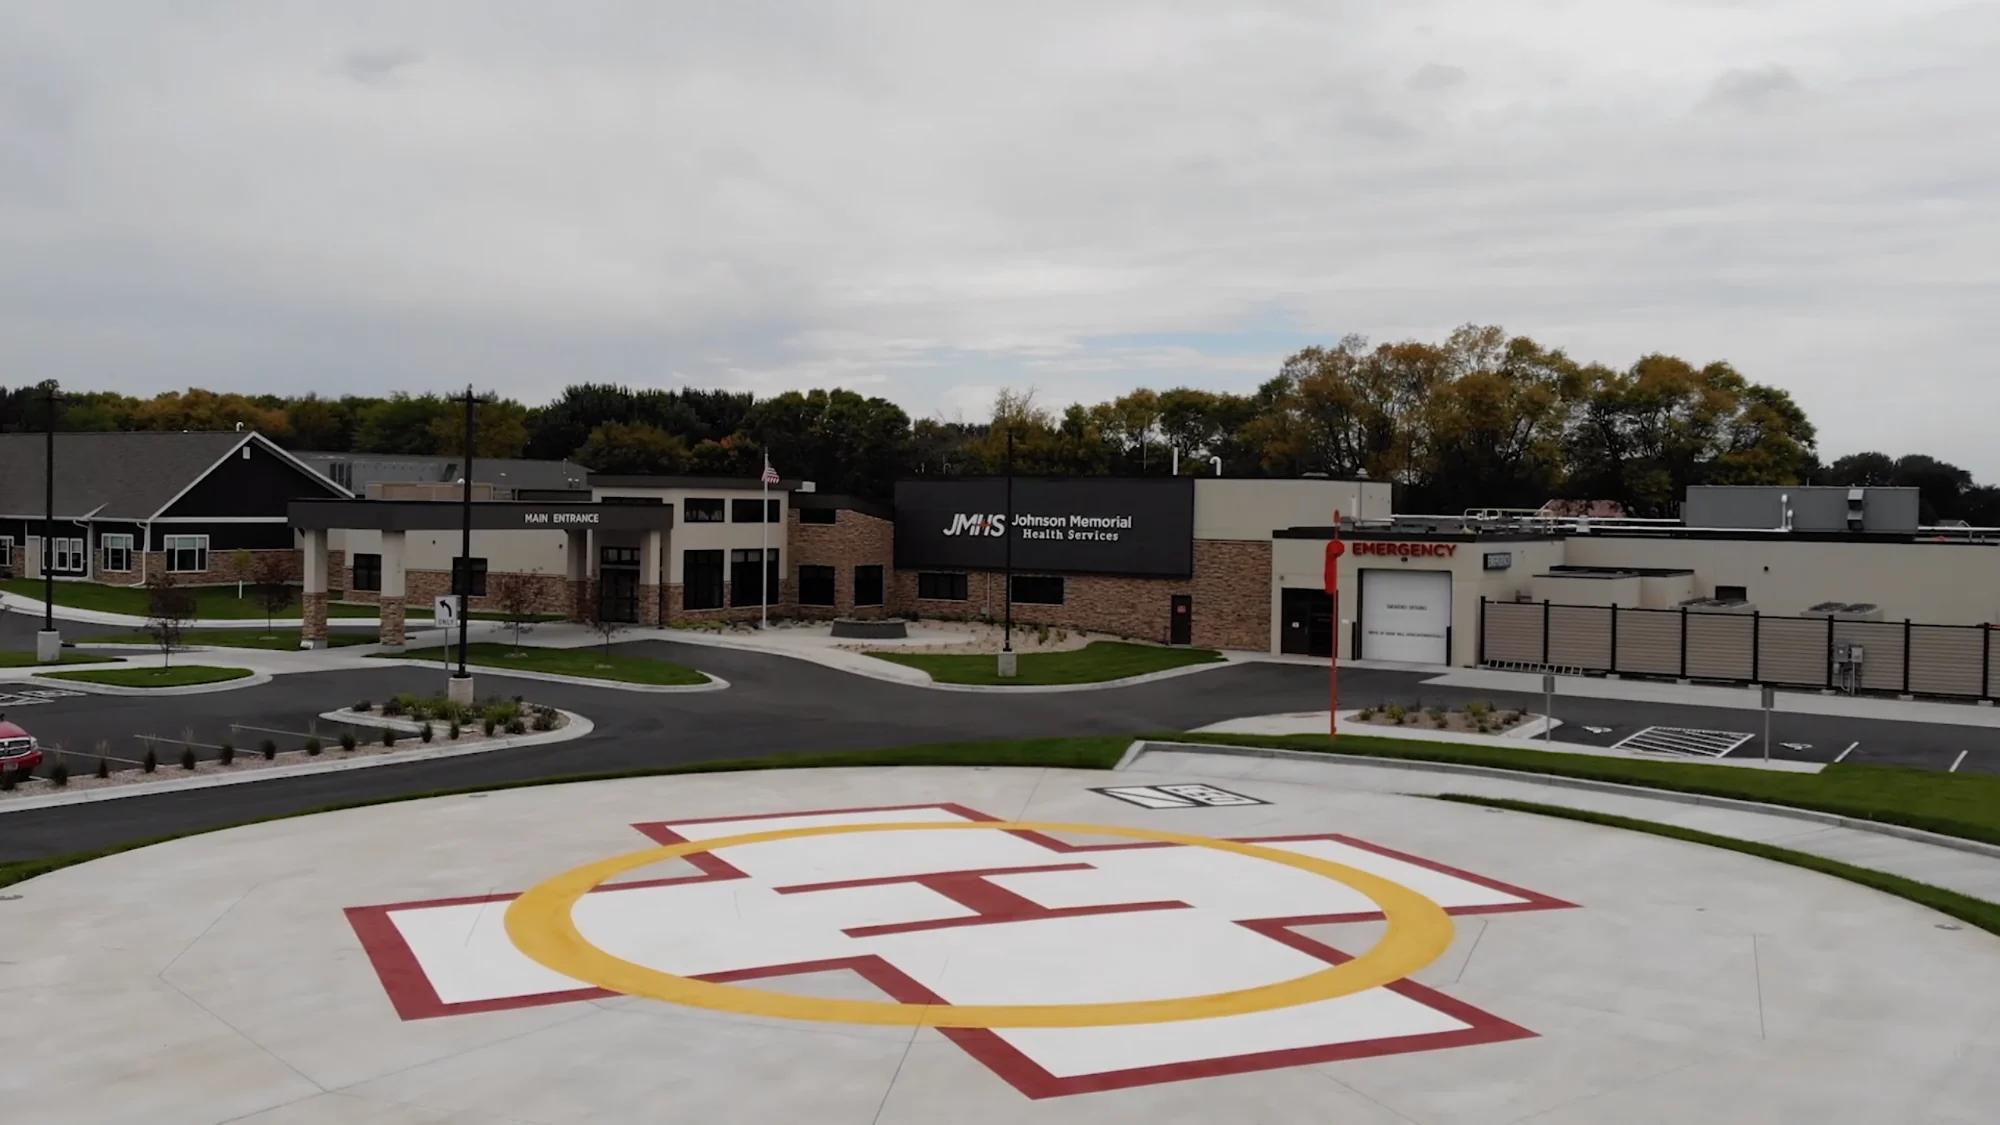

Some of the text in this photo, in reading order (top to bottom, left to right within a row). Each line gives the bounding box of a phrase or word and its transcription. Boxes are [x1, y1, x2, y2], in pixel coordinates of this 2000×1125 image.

[524, 513, 600, 523] MAIN ENTRANCE
[943, 513, 1006, 537] JMHS
[1011, 514, 1132, 528] Johnson Memorial
[1023, 529, 1119, 541] Health Services
[1352, 542, 1458, 557] EMERGENCY
